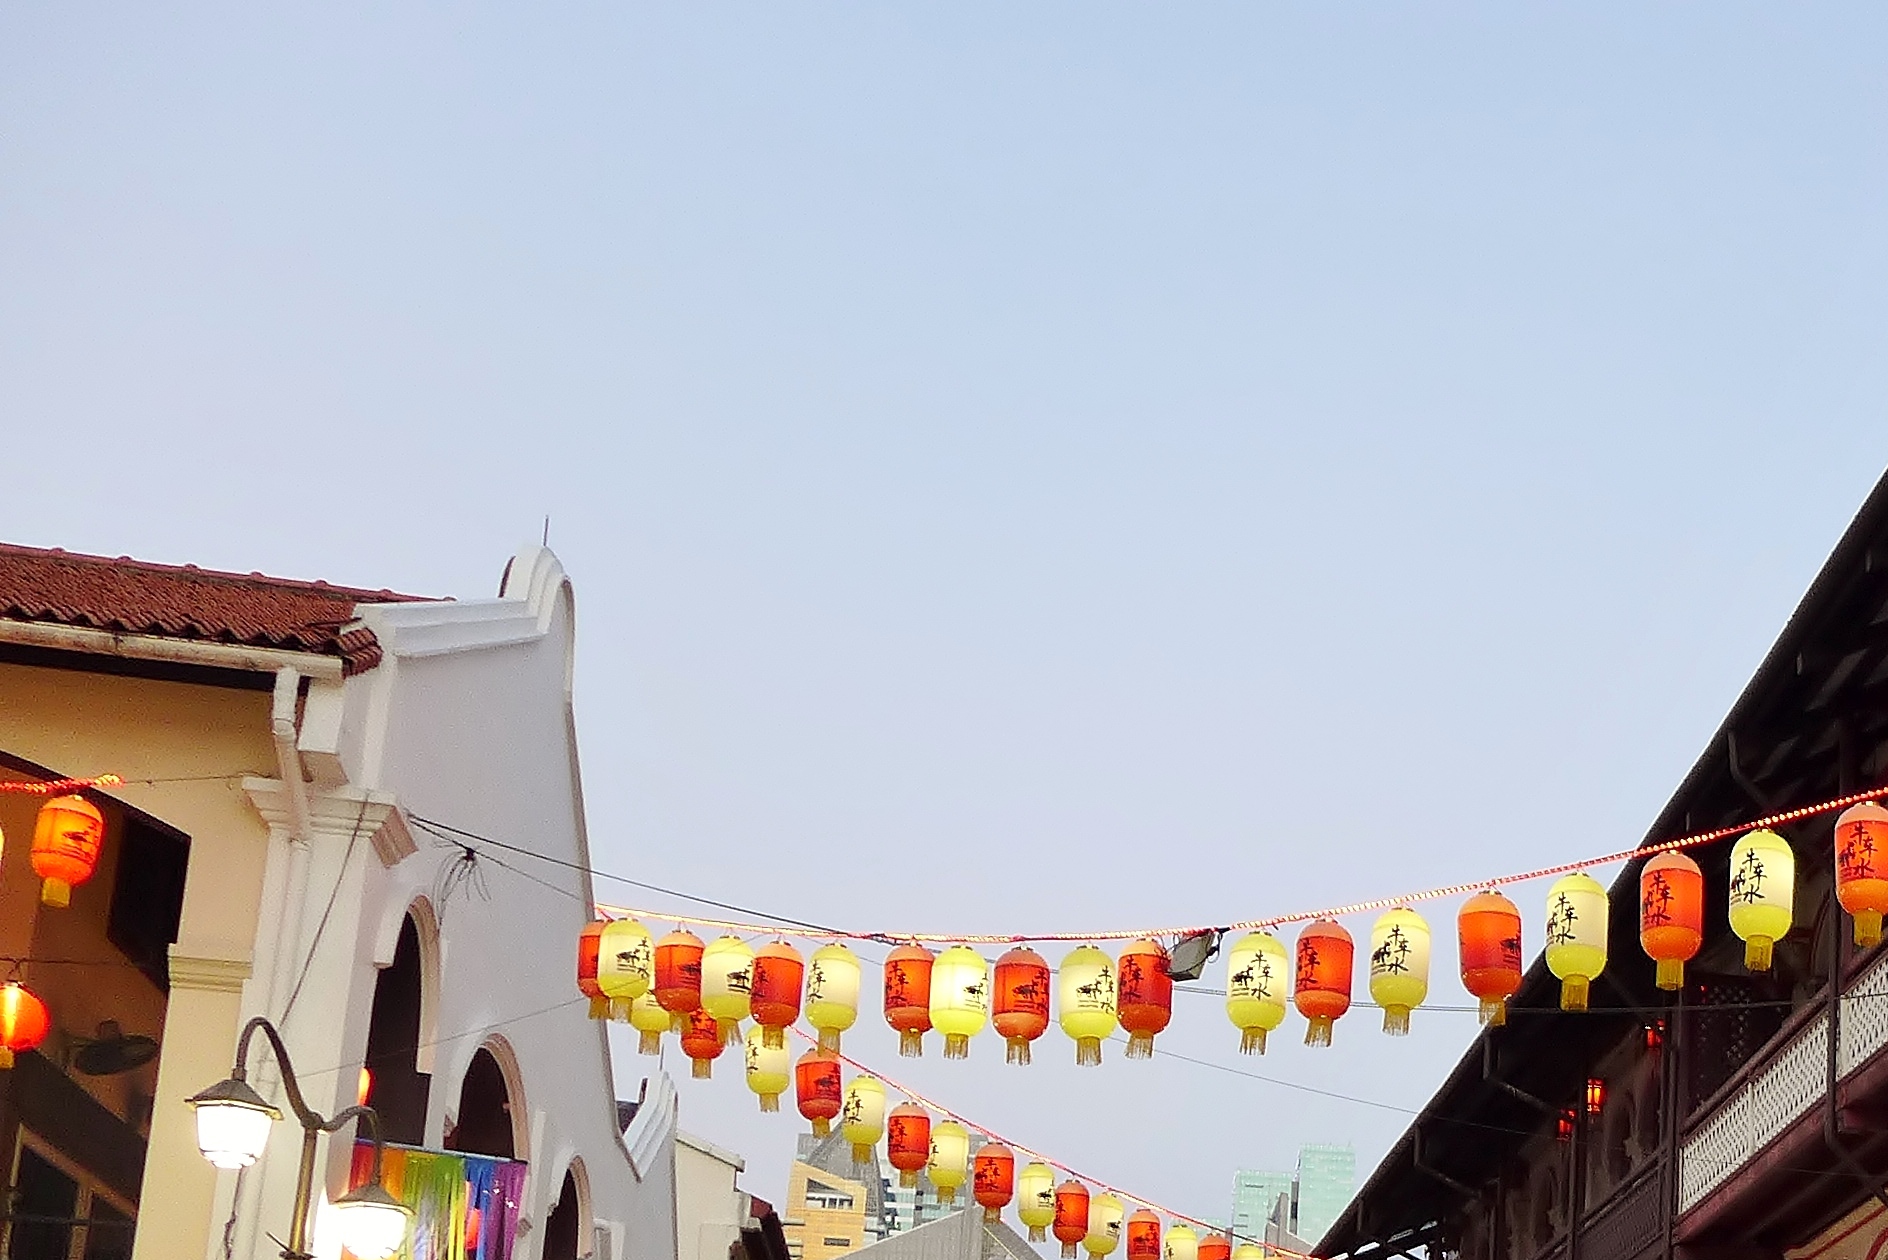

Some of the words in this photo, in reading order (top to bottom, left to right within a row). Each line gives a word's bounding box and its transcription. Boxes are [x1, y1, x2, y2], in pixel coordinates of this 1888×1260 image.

[1740, 848, 1767, 903] 牛车水
[1850, 822, 1878, 879] 牛车水
[1554, 892, 1578, 944] 牛车水
[1649, 871, 1674, 926] 牛车水
[1251, 950, 1274, 1000] 牛车水
[1298, 938, 1320, 986] 牛车水
[1387, 924, 1412, 975] 牛车水
